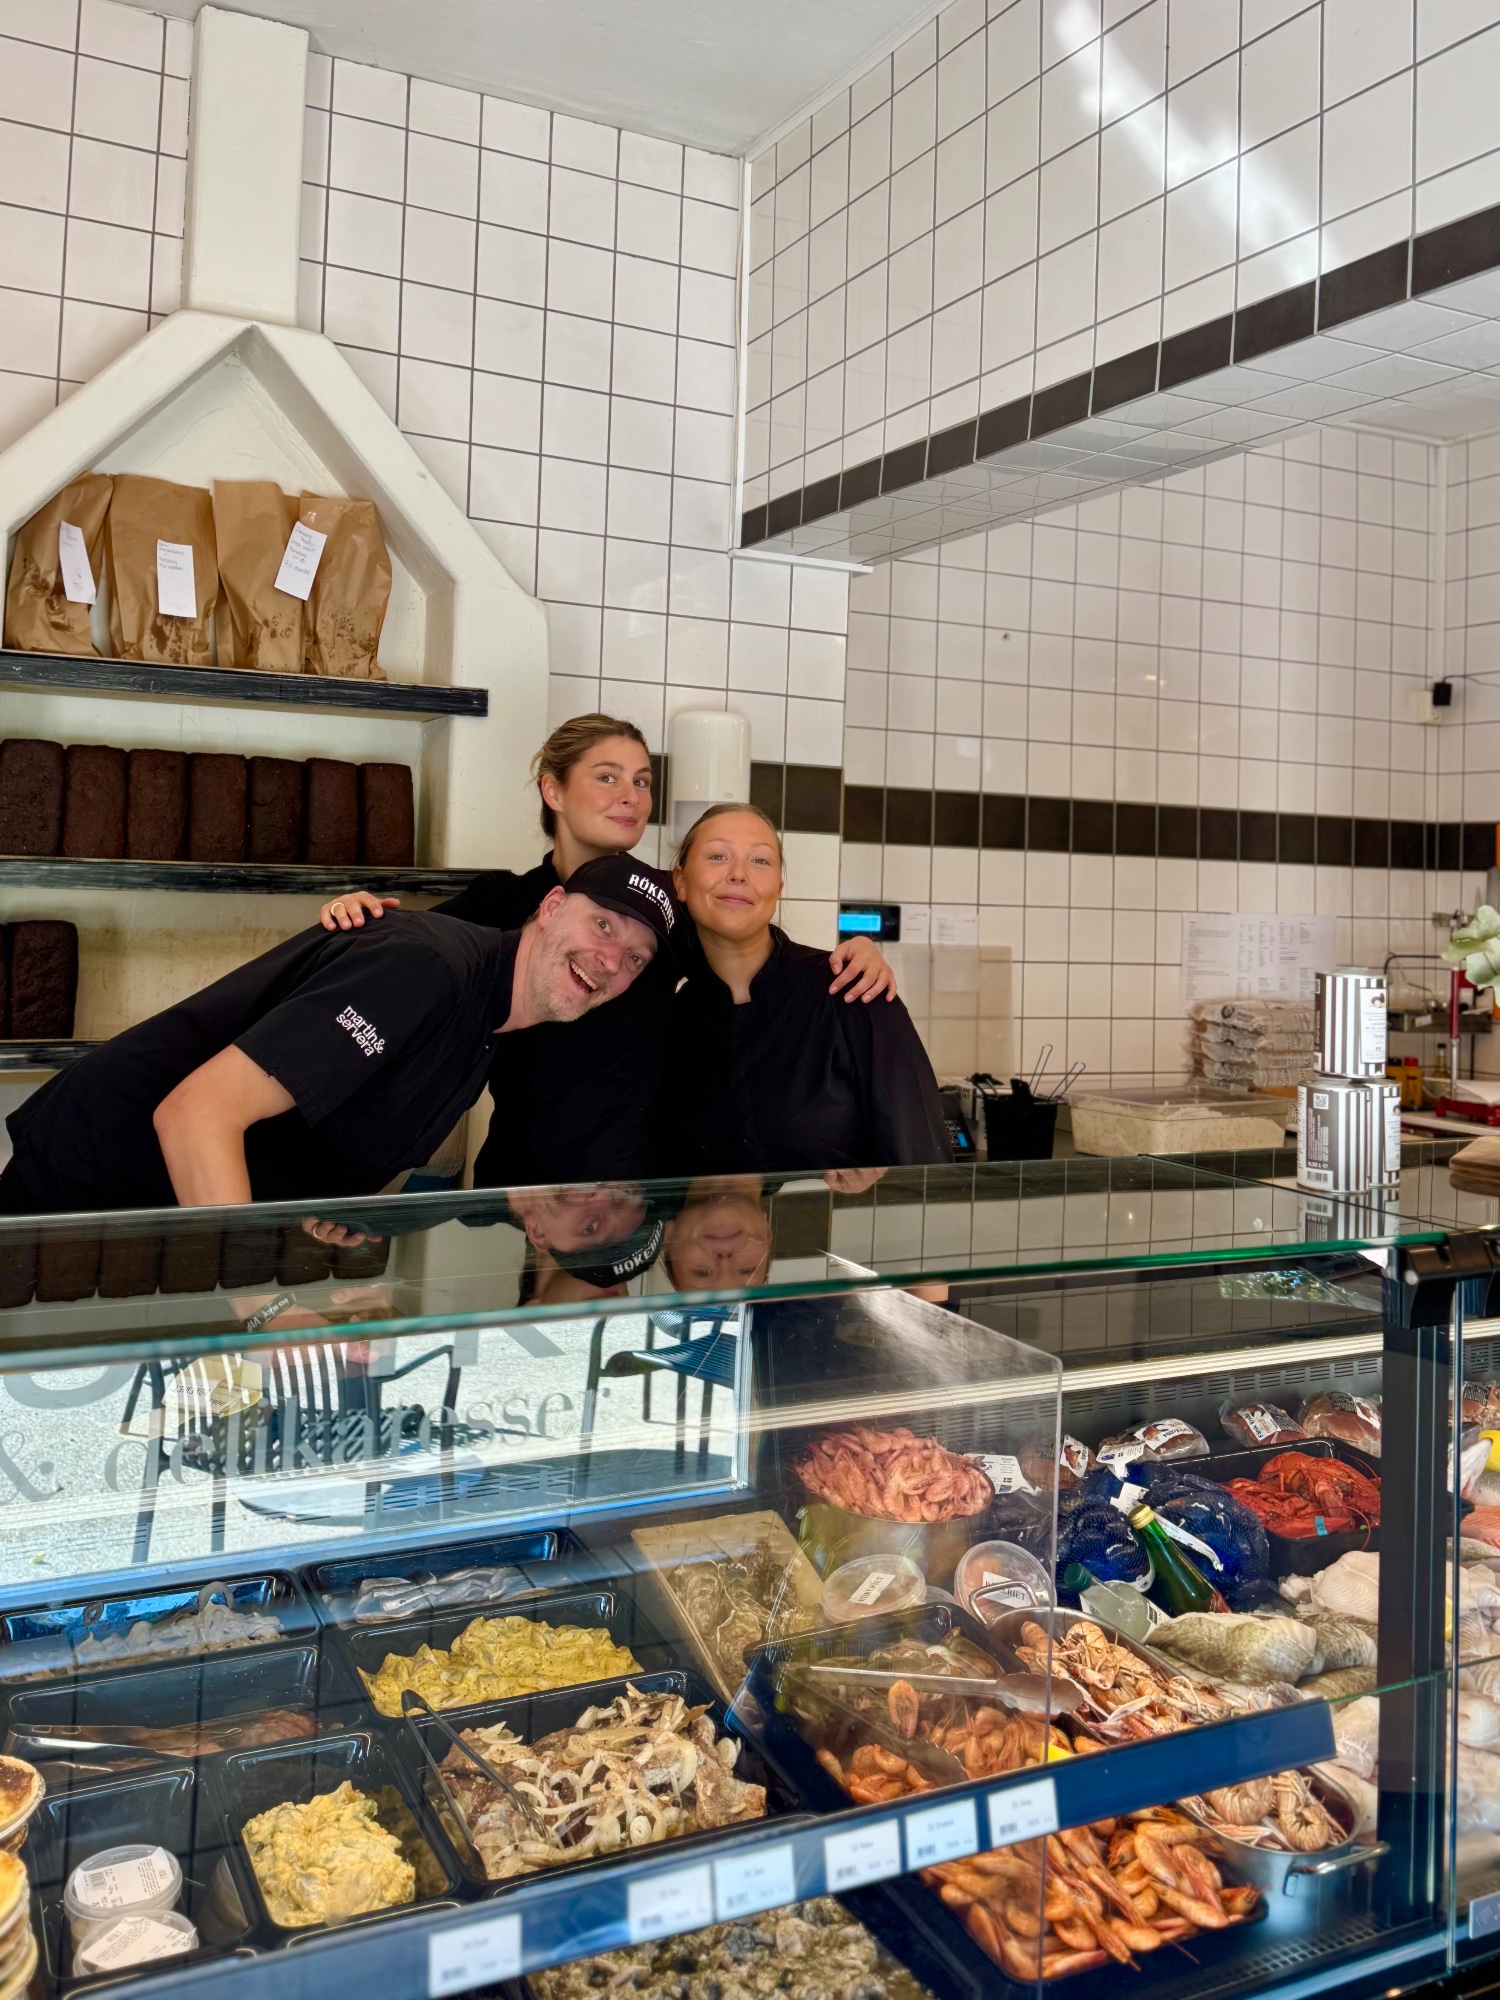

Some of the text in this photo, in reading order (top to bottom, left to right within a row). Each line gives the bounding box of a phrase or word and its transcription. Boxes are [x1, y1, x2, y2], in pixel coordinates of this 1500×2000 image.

[335, 1013, 375, 1057] servera
[343, 1005, 386, 1054] martin&
[247, 1316, 261, 1331] VIP
